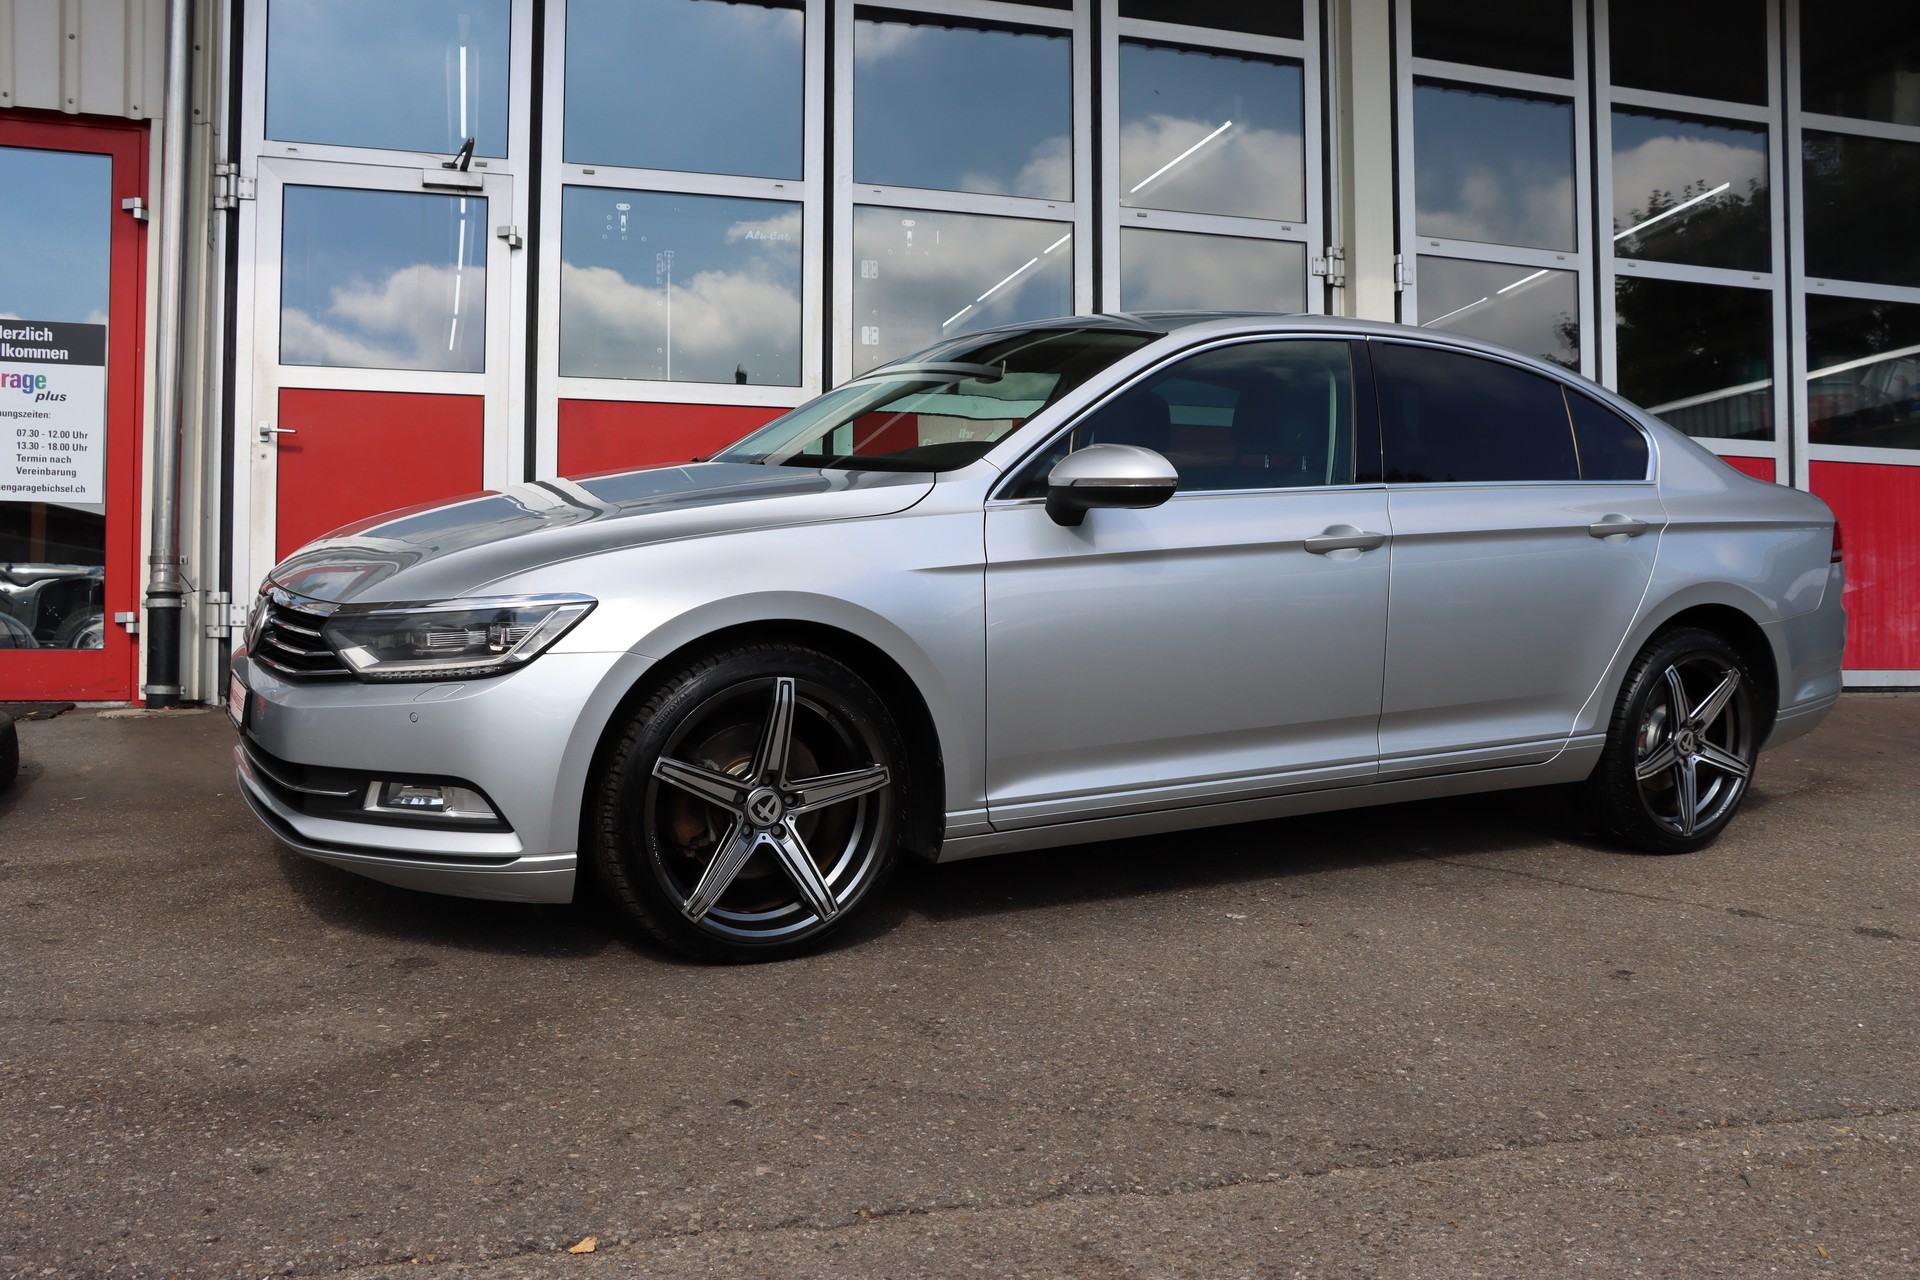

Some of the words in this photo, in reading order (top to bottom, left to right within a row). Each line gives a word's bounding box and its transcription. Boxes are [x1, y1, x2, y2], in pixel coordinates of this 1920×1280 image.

[1, 343, 69, 360] lkommen
[1, 373, 47, 394] rage
[35, 391, 67, 403] plus
[16, 429, 39, 438] 07.30
[48, 430, 70, 439] 12.00
[72, 431, 88, 439] Uhr
[17, 441, 39, 450] 13.30
[48, 443, 70, 451] 18.00
[72, 443, 88, 452] Uhr
[16, 454, 47, 463] Termin
[49, 456, 72, 464] nach
[16, 466, 77, 479] Vereinbarung
[651, 692, 691, 734] UNIROYAL
